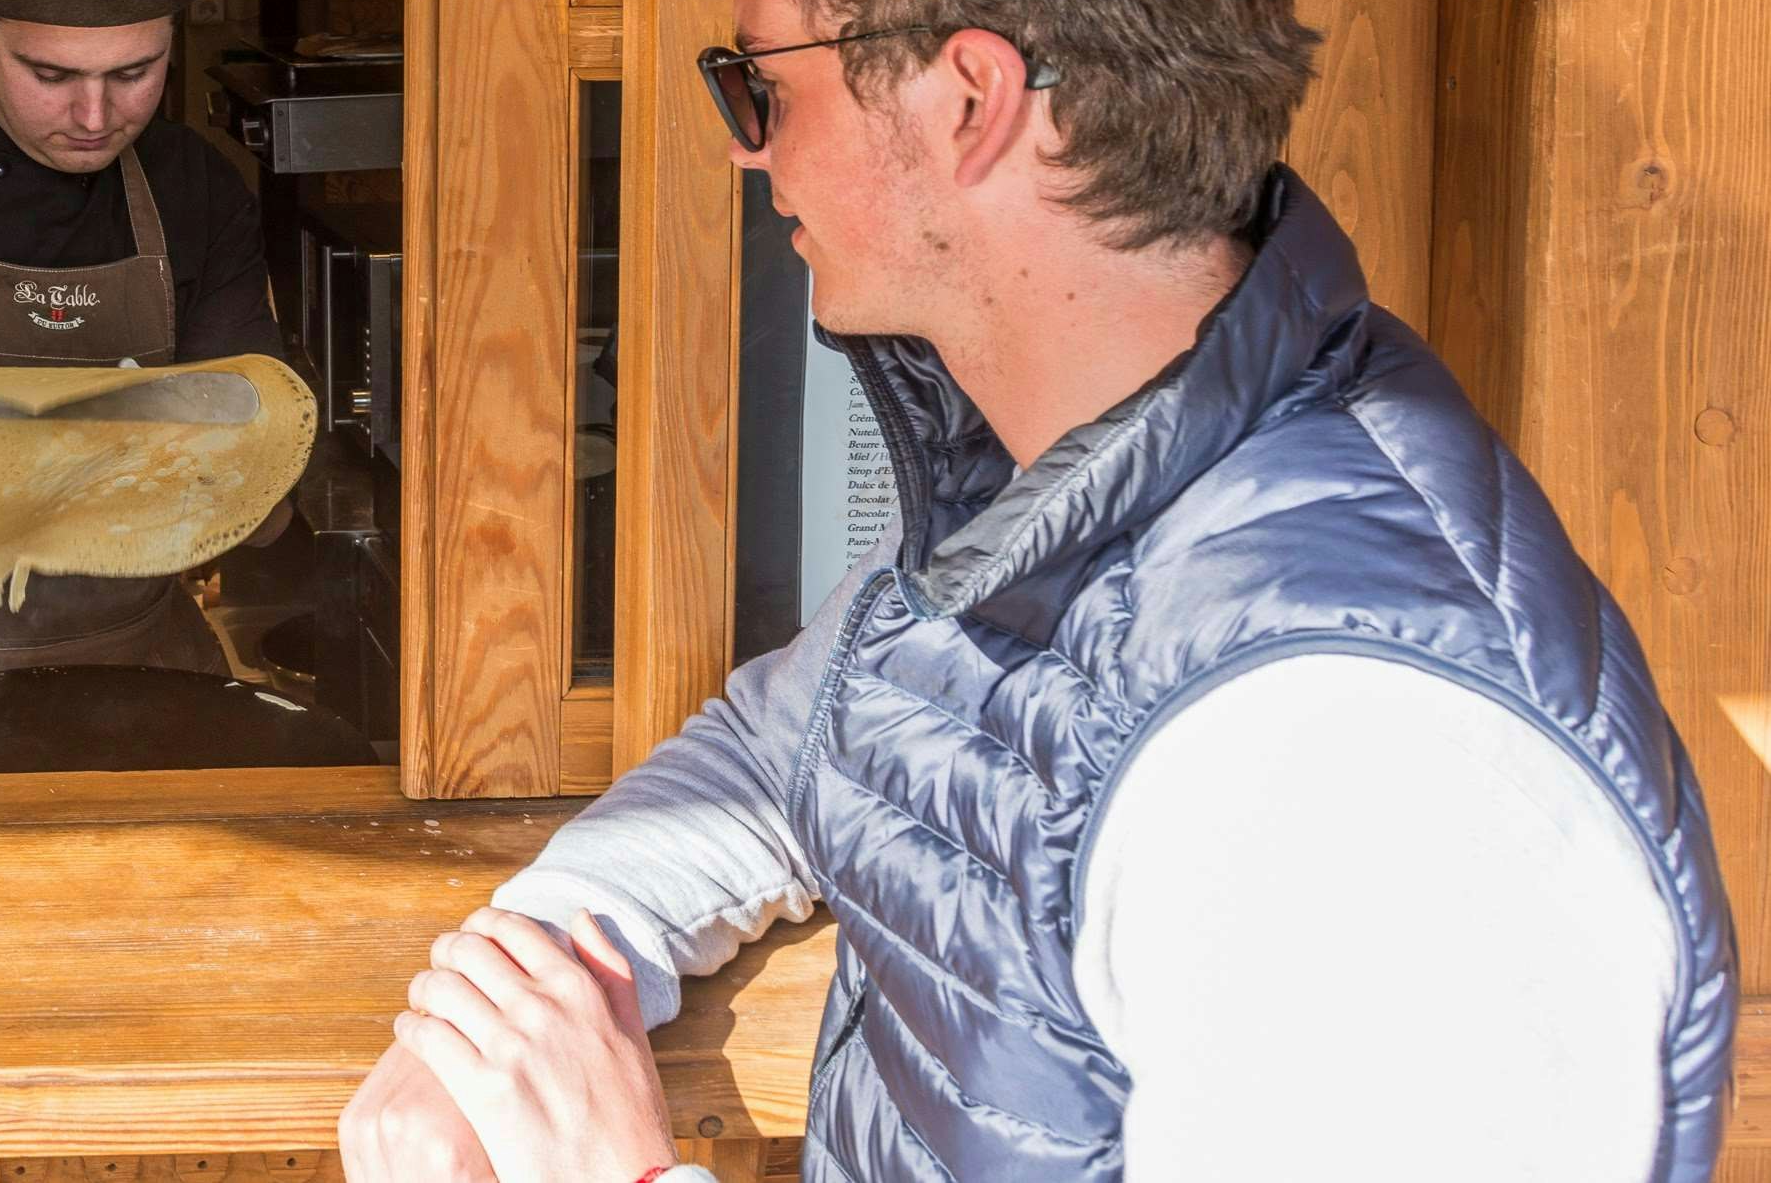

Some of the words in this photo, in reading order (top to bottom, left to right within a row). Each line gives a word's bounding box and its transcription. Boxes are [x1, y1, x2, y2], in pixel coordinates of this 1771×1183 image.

[13, 280, 46, 304] La
[48, 284, 101, 309] Table
[848, 440, 880, 449] Beurre
[847, 452, 869, 461] Miel
[847, 466, 872, 477] Sirop
[847, 480, 875, 489] Dulce
[877, 480, 890, 489] de
[848, 495, 890, 504] Chocolat
[848, 509, 890, 518] Chocolat
[848, 523, 877, 532] Grand
